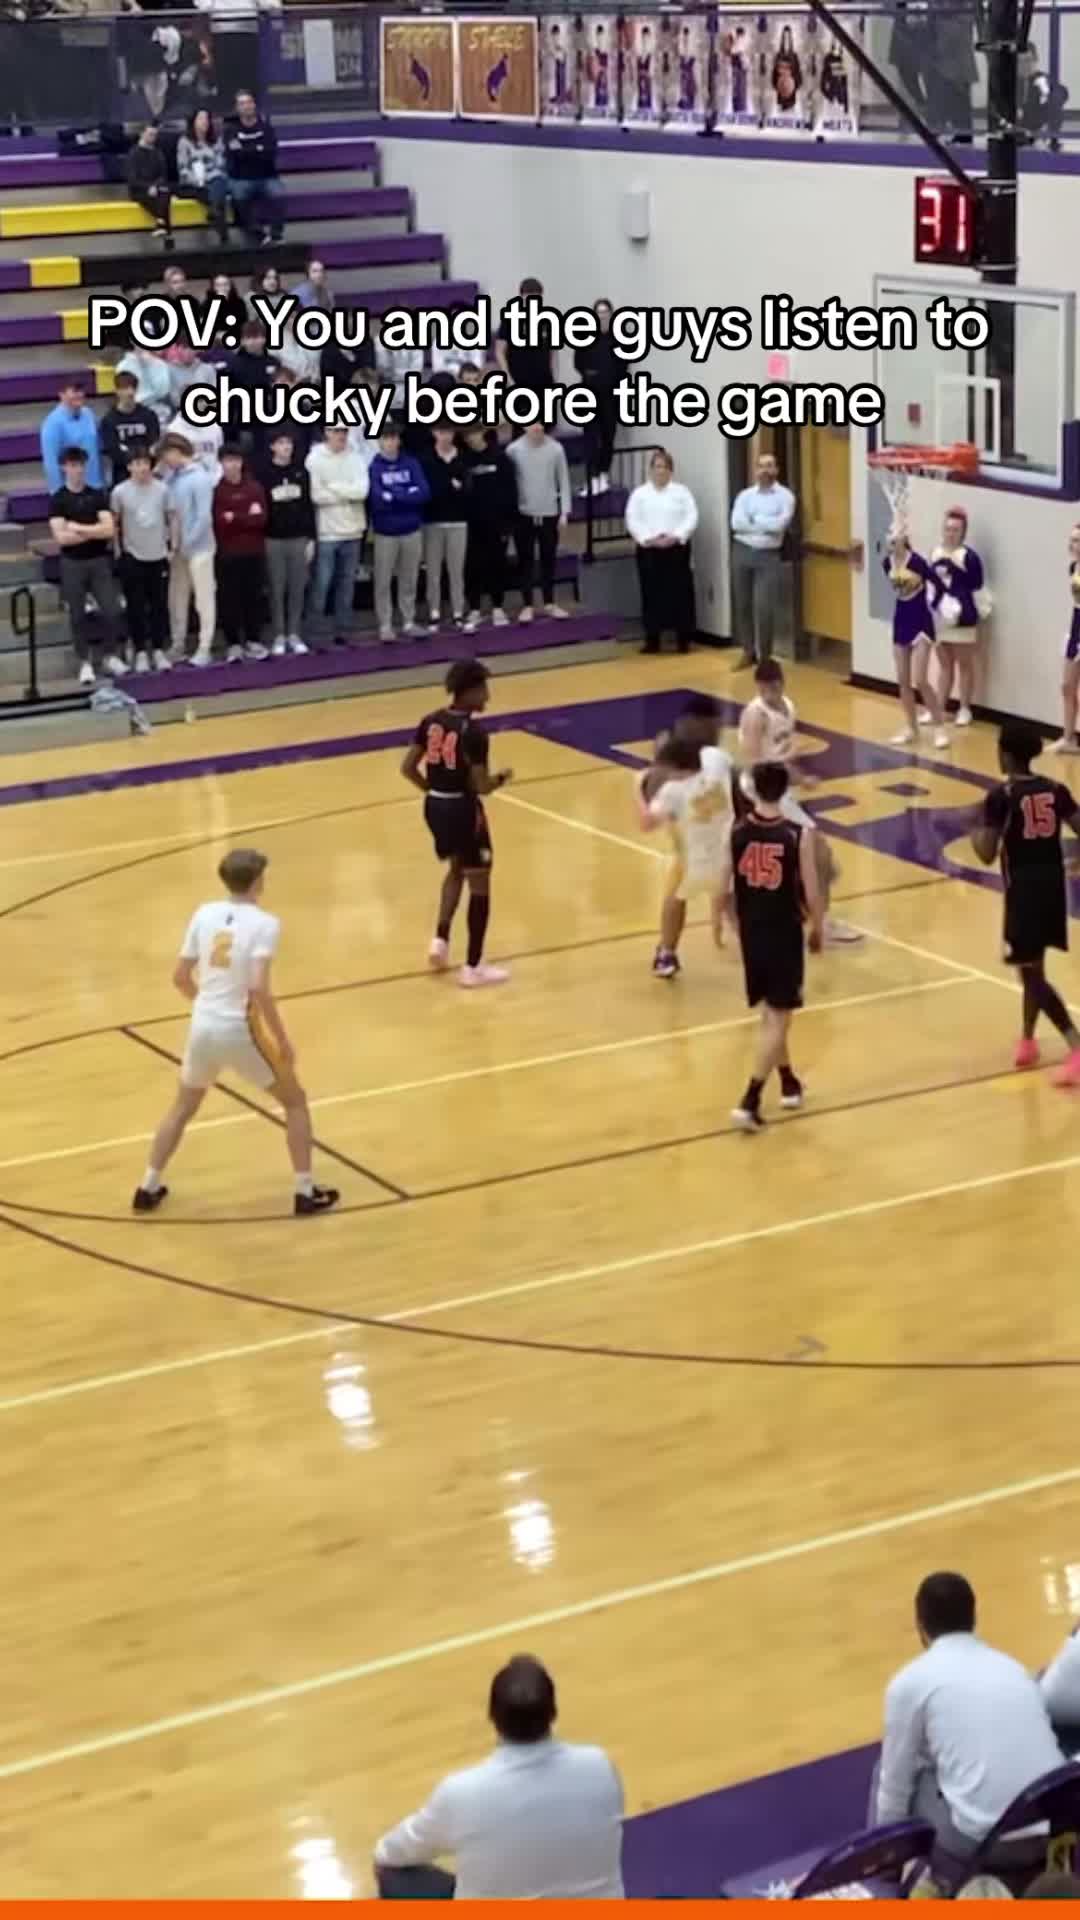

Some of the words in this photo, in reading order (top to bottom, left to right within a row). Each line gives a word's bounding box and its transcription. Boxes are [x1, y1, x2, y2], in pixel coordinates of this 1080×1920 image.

[919, 187, 966, 253] 31
[426, 722, 458, 770] 24
[1020, 791, 1056, 840] 15
[738, 841, 785, 890] 45
[209, 931, 234, 969] 2
